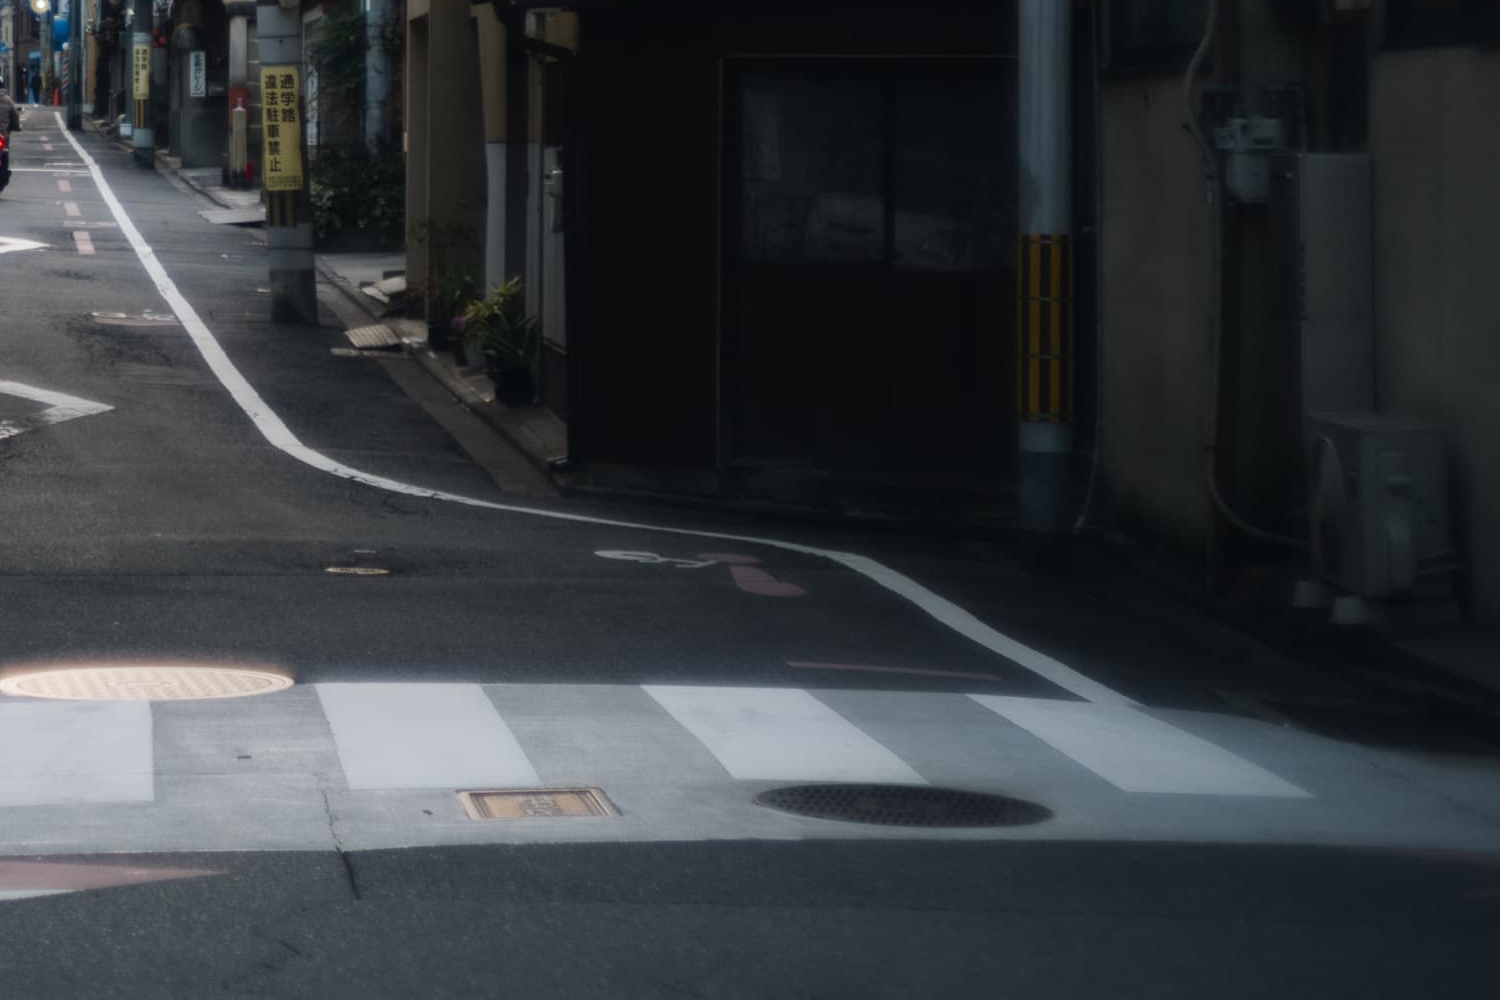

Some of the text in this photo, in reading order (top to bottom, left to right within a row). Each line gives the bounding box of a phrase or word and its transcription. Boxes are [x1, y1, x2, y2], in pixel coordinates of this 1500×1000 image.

[265, 74, 282, 172] 違法駐車禁止
[280, 74, 296, 122] 通学路
